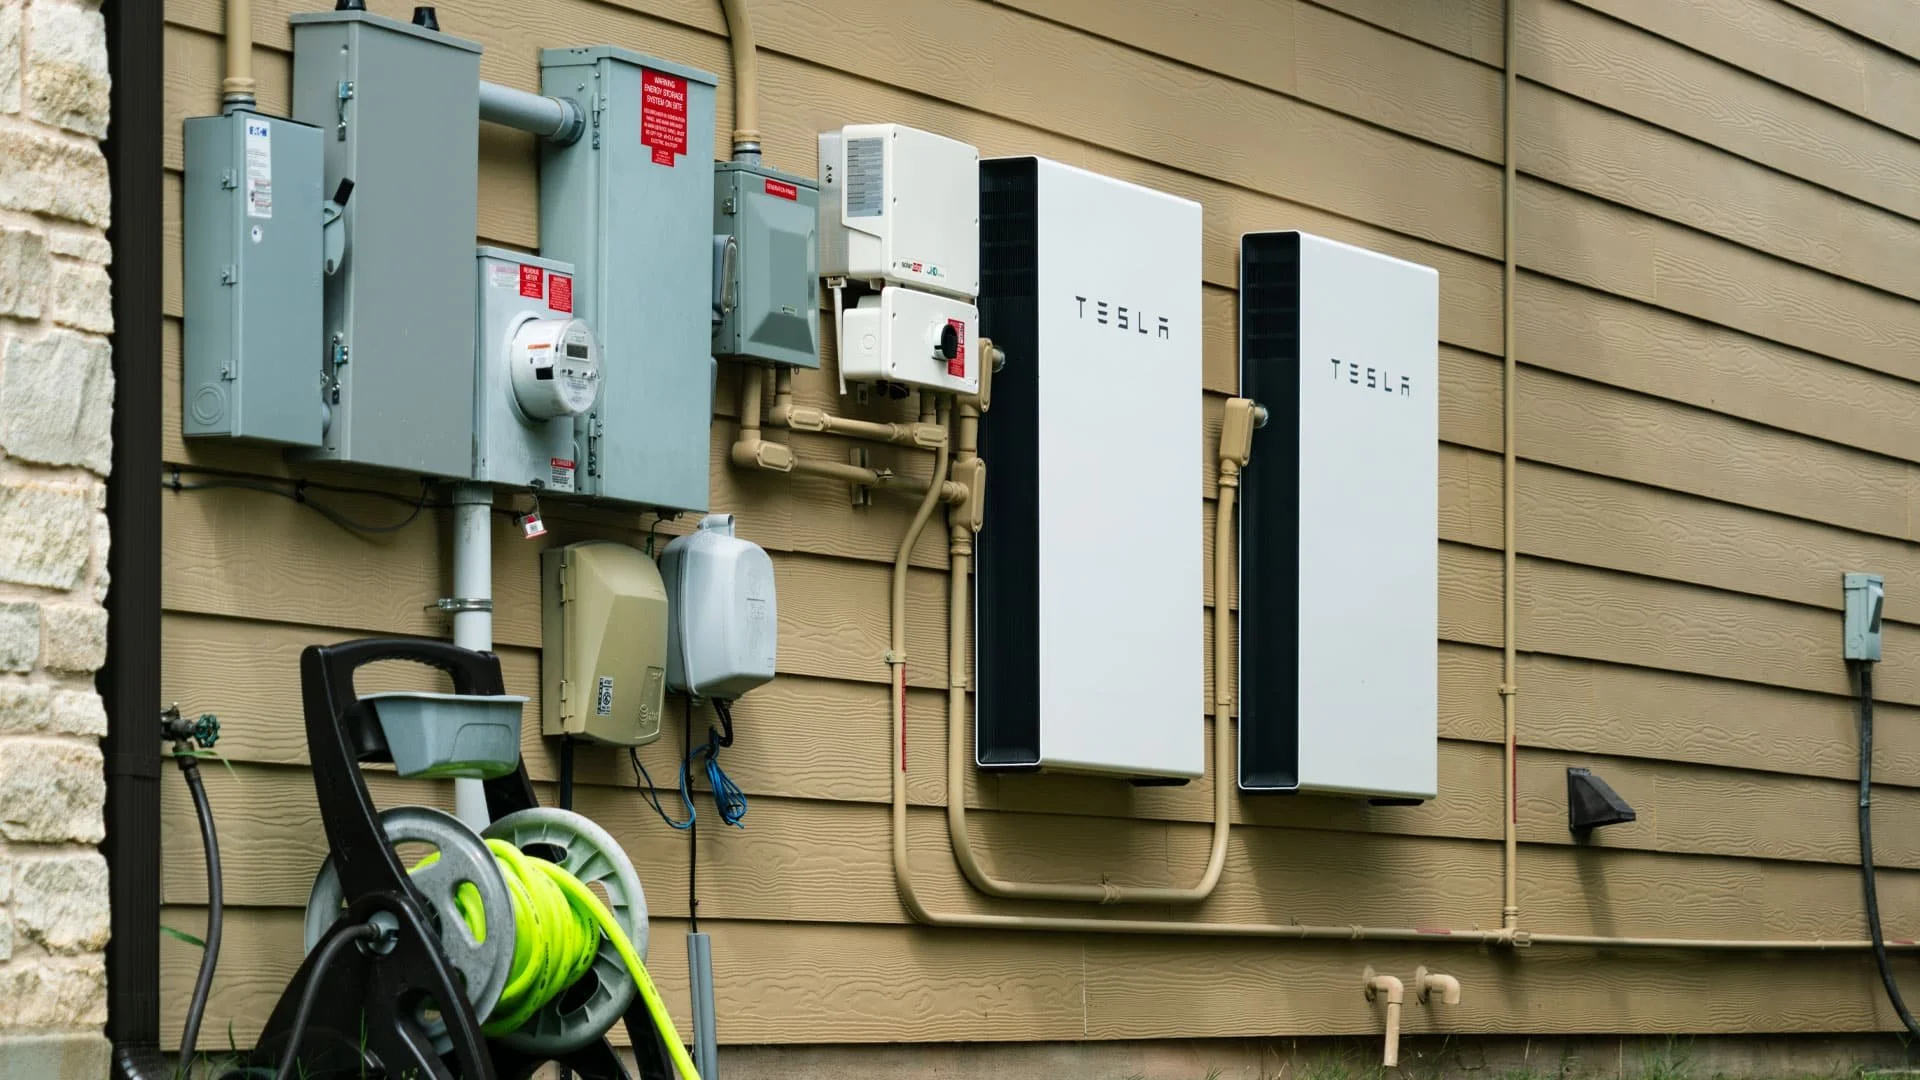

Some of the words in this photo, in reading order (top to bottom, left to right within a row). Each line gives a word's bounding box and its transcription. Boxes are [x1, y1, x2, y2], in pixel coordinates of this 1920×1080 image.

[654, 77, 675, 88] WARNING
[644, 83, 662, 95] ENERGY
[663, 89, 683, 101] STORAGE
[647, 95, 664, 106] SYSTEM
[665, 99, 672, 108] ON
[672, 101, 683, 111] SITE
[249, 126, 267, 137] EATON
[525, 273, 538, 281] METER
[1075, 295, 1169, 340] TESLA
[1331, 357, 1410, 398] TESLA
